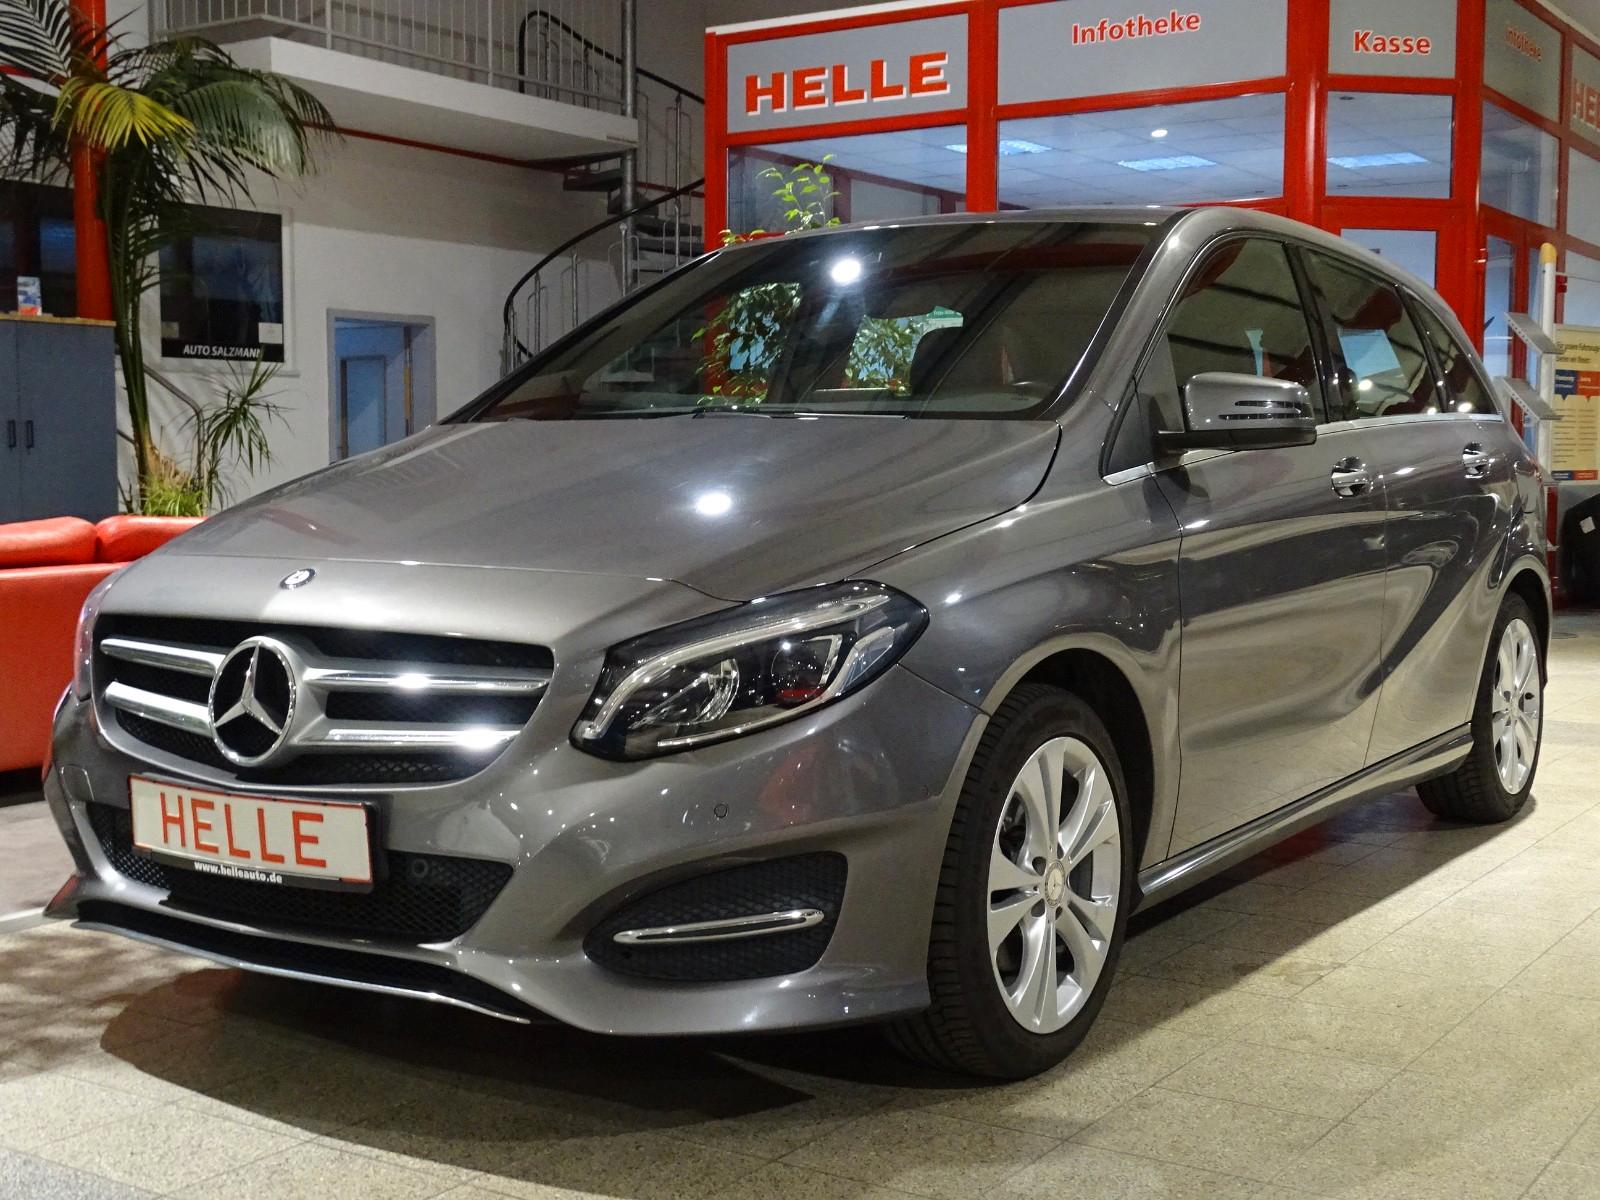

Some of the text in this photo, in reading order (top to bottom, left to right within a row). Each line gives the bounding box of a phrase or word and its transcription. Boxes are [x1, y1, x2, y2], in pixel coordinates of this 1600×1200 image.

[1072, 9, 1201, 45] Infotheke
[1353, 30, 1431, 55] Kasse
[745, 52, 950, 116] HELLE
[183, 344, 210, 356] AUTO
[160, 792, 326, 868] HELLE
[194, 861, 282, 883] www.helleauto.de
